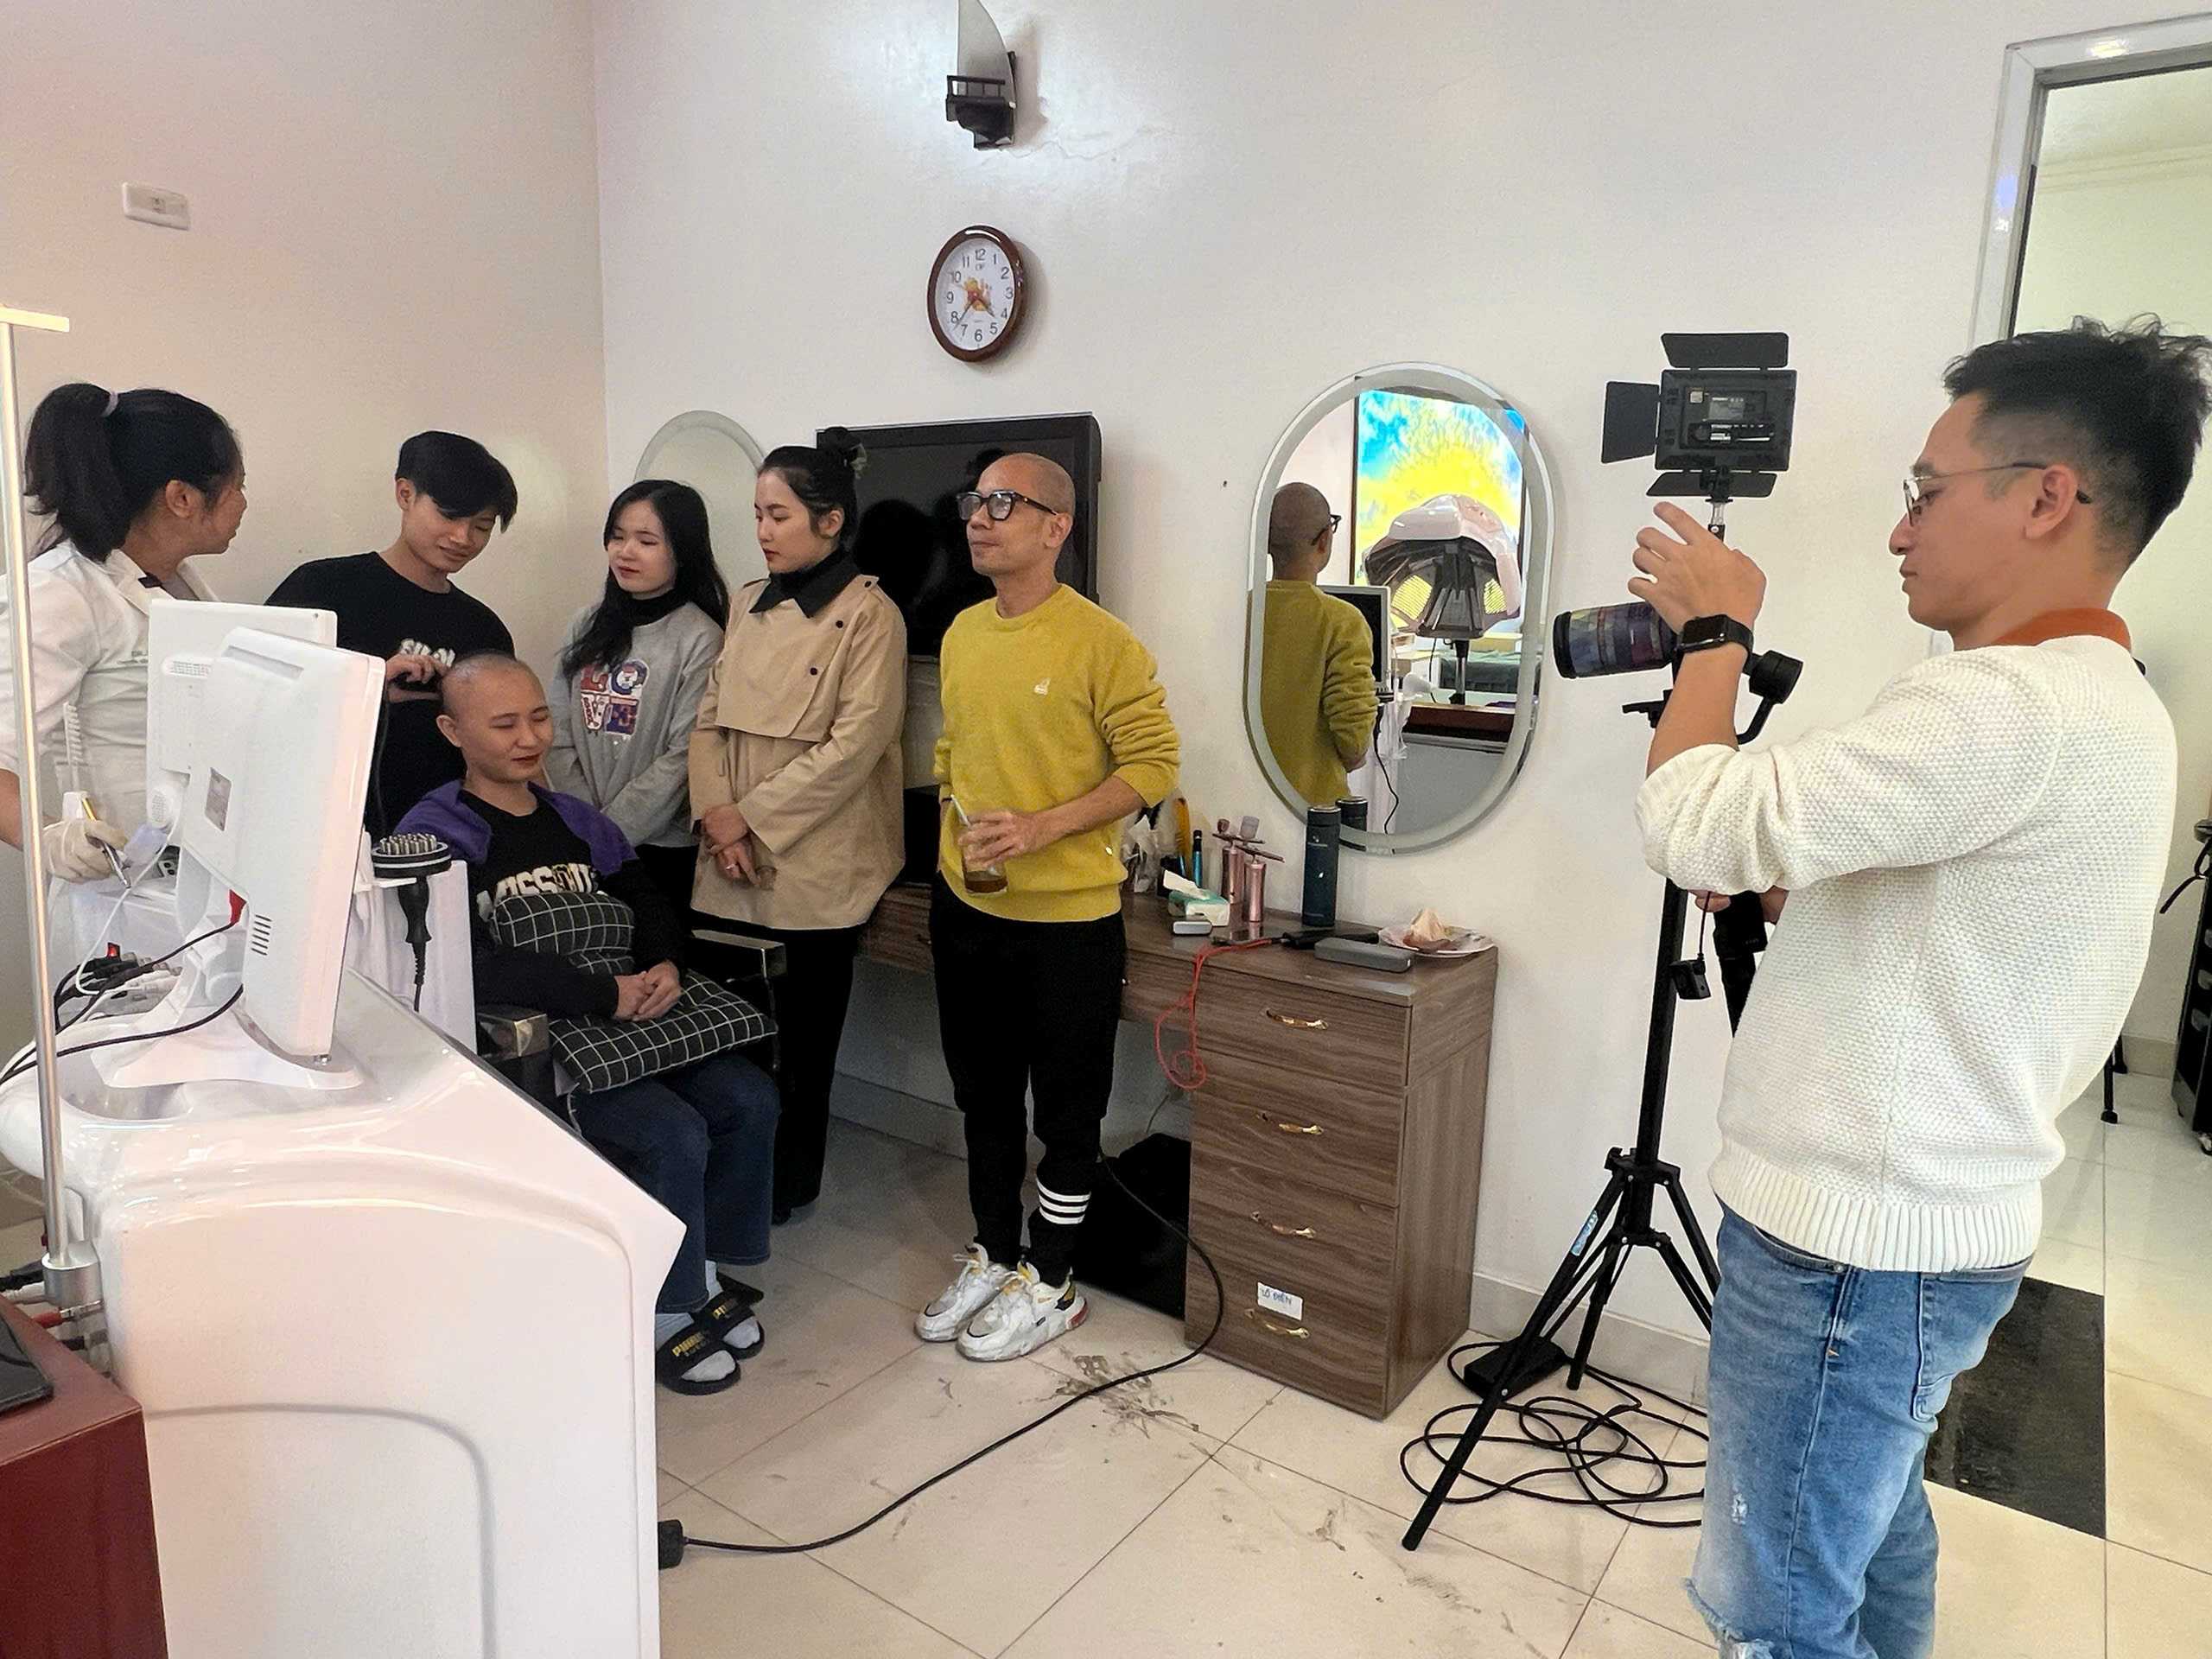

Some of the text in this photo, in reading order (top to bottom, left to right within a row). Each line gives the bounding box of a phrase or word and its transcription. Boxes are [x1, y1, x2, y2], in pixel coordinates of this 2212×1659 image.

[975, 248, 986, 260] 12
[962, 255, 969, 268] 11
[1001, 266, 1009, 280] 2
[946, 291, 954, 304] 9
[1005, 287, 1014, 300] 3
[950, 311, 959, 323] 8
[1001, 308, 1007, 319] 4
[961, 324, 968, 337] 7
[989, 322, 998, 334] 5
[974, 329, 982, 342] 6
